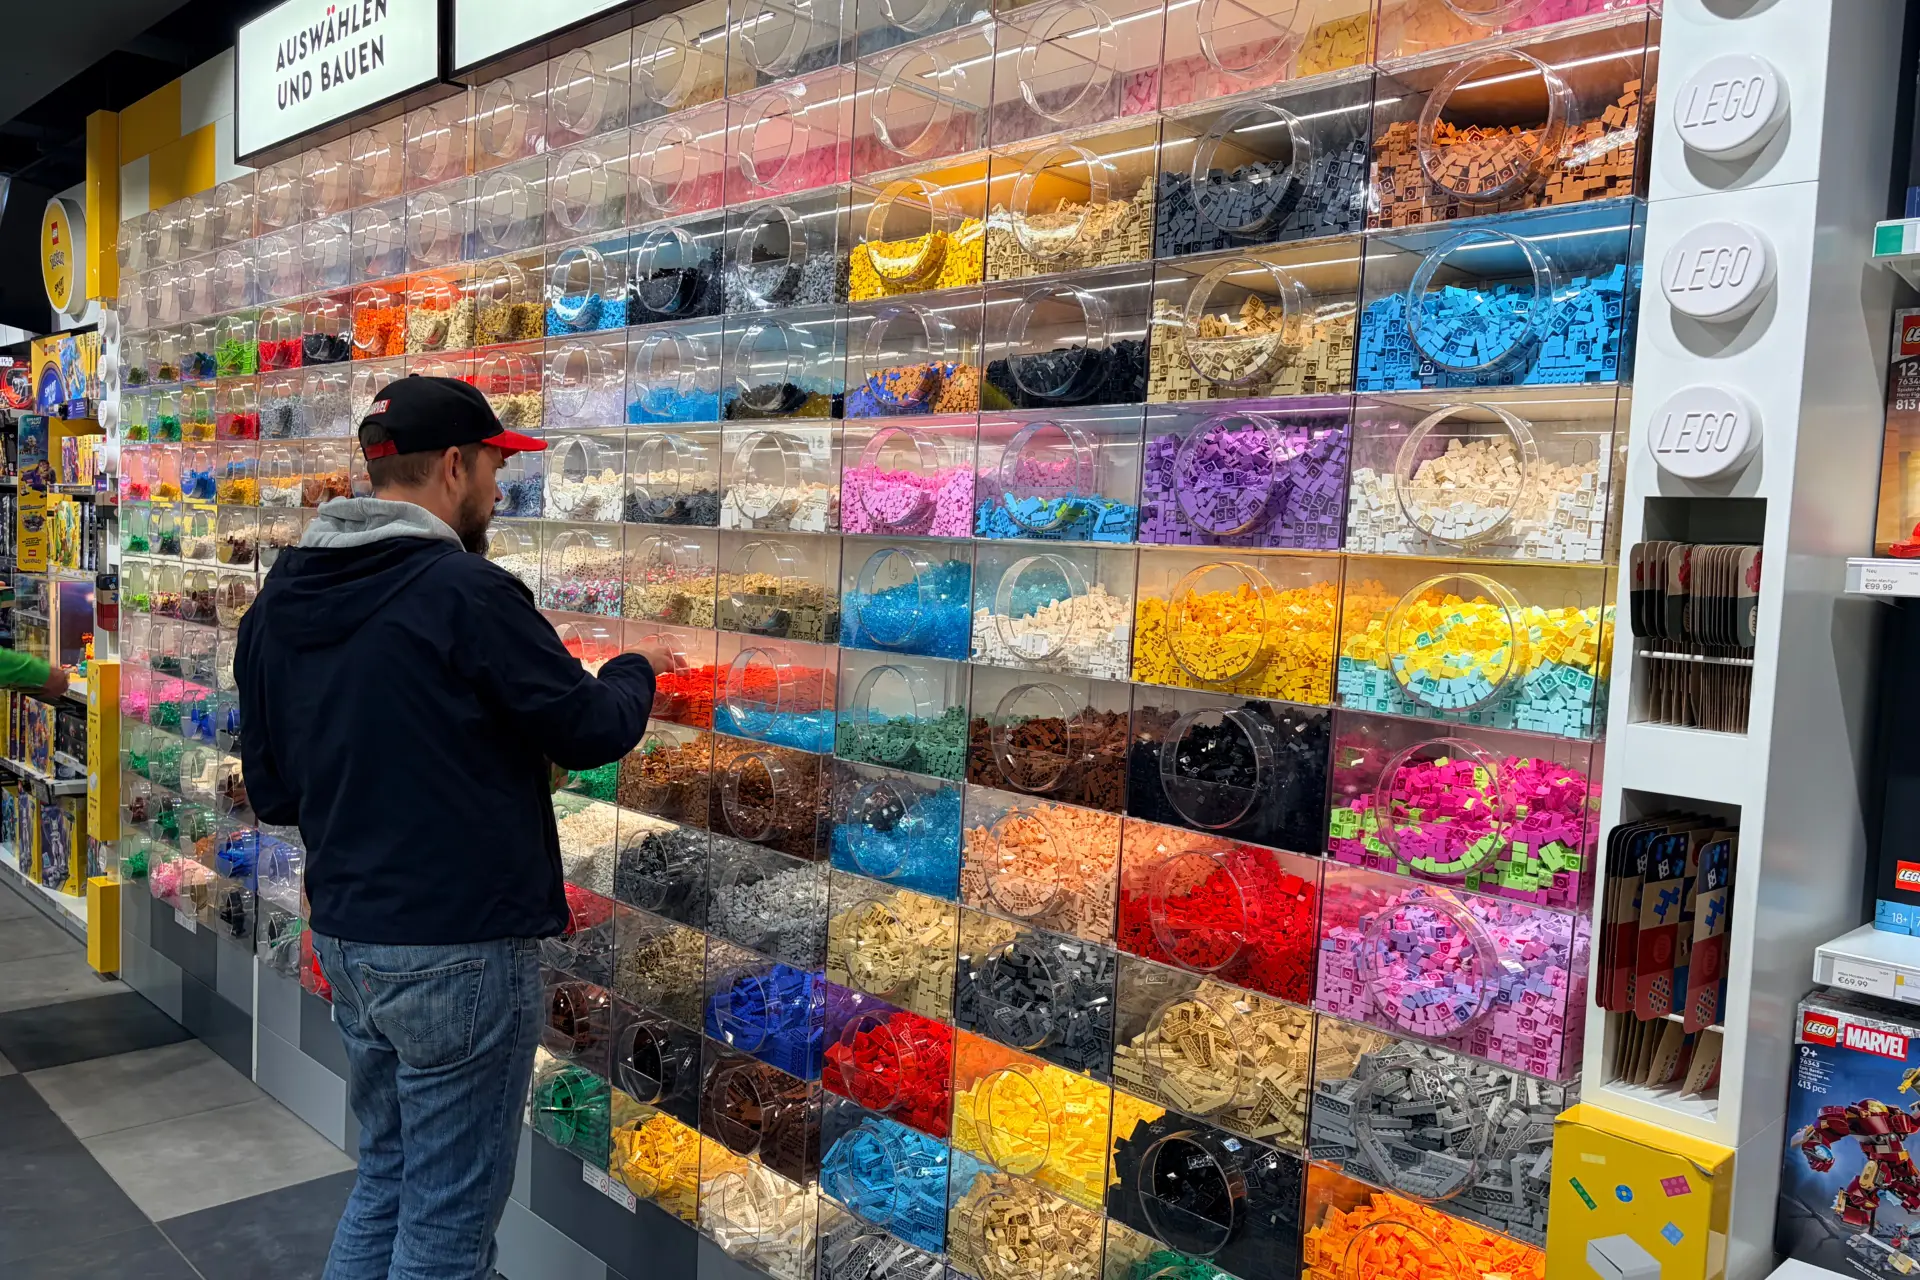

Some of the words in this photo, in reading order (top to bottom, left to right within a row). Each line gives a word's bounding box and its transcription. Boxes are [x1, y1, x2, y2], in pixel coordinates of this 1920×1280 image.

[276, 0, 386, 72] AUSWÄHLEN
[278, 70, 312, 110] UND
[321, 34, 384, 91] BAUEN
[1683, 76, 1764, 128] LEGO
[1670, 246, 1751, 292] LEGO
[1896, 399, 1916, 410] 813
[1656, 411, 1737, 453] LEGO
[1865, 583, 1893, 591] €99.99
[1892, 912, 1907, 923] 18+
[1838, 976, 1868, 987] €69.99
[1805, 1022, 1834, 1036] LEGO
[1846, 1027, 1905, 1058] MARVEL
[1801, 1046, 1818, 1058] 9+
[1800, 1058, 1820, 1068] 76343
[1797, 1080, 1812, 1090] 413
[1812, 1085, 1827, 1094] pcs
